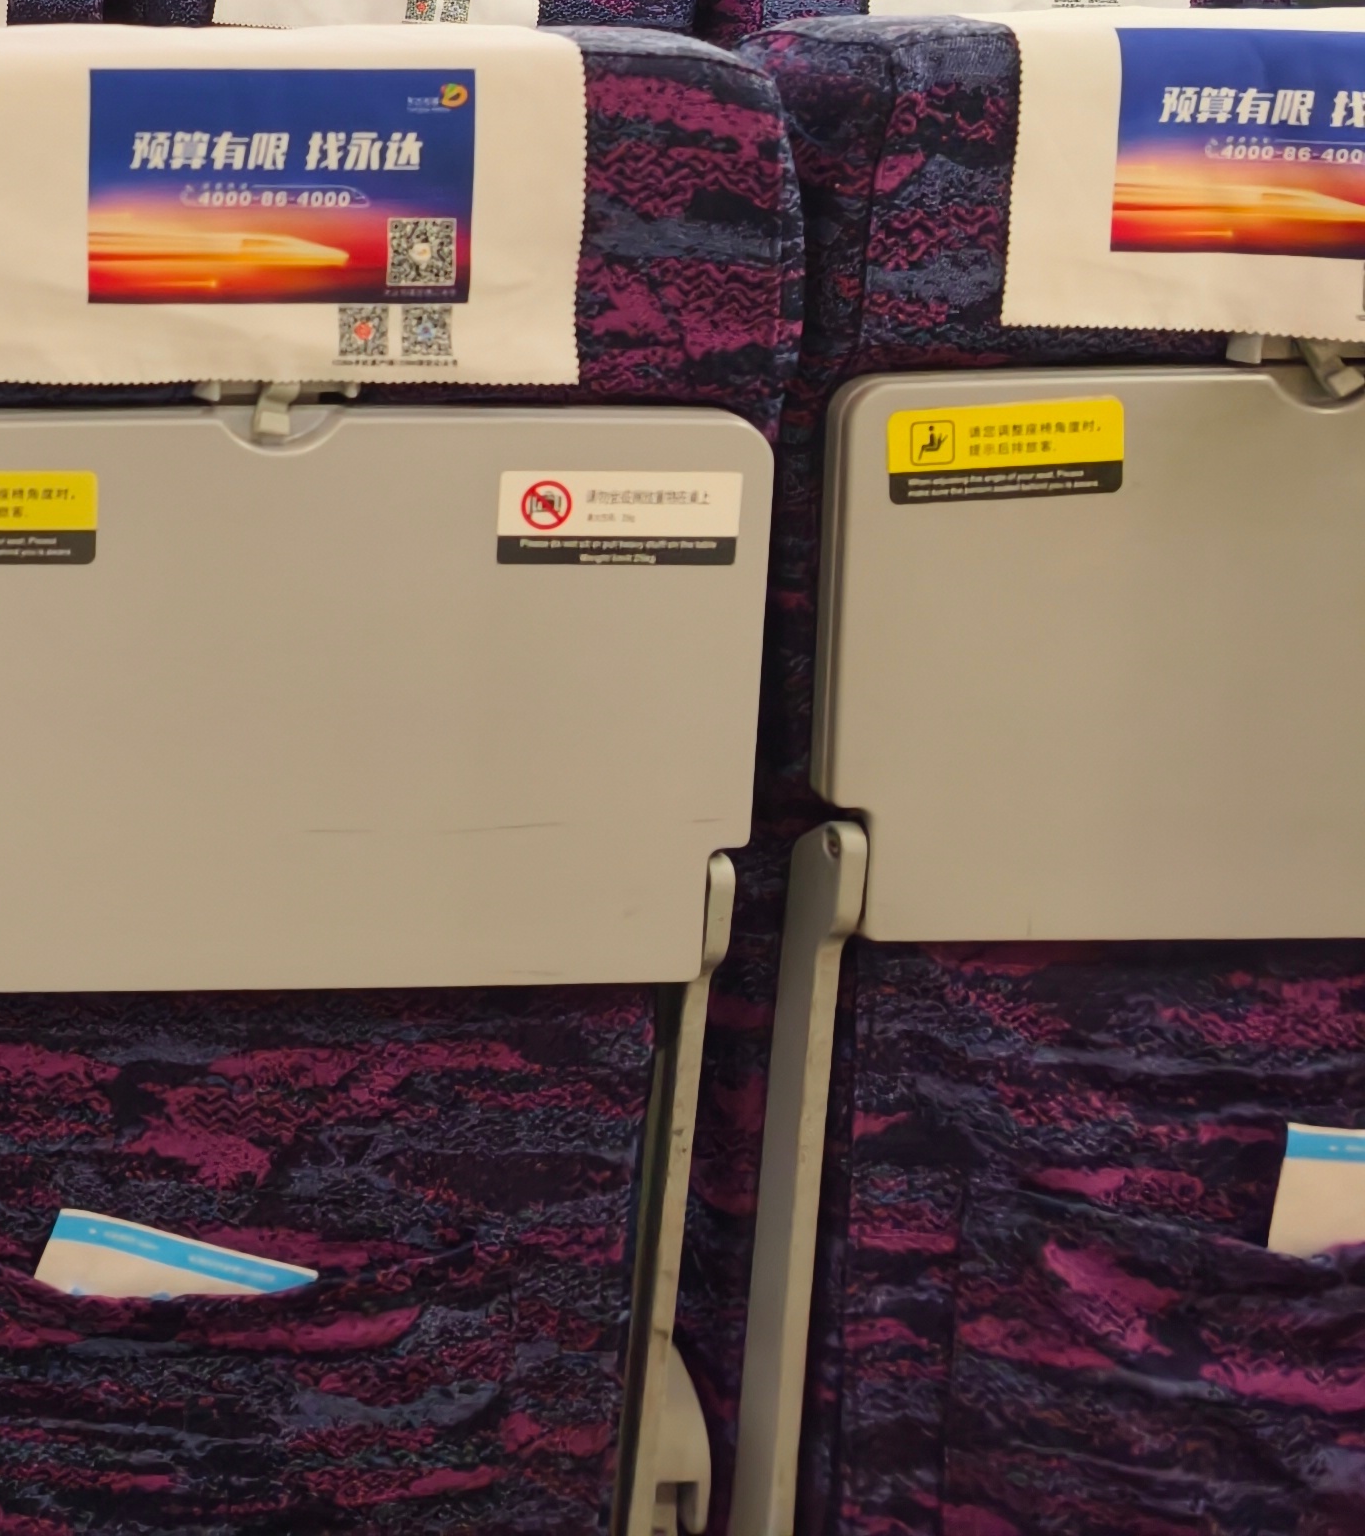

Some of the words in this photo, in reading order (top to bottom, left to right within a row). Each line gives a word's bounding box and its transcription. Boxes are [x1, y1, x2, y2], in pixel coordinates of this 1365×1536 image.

[1160, 87, 1315, 125] 预算有限
[131, 131, 289, 171] 预算有限
[305, 131, 423, 171] 找永达
[1221, 145, 1365, 163] 4000-86-400
[197, 190, 352, 208] 4000-86-4000
